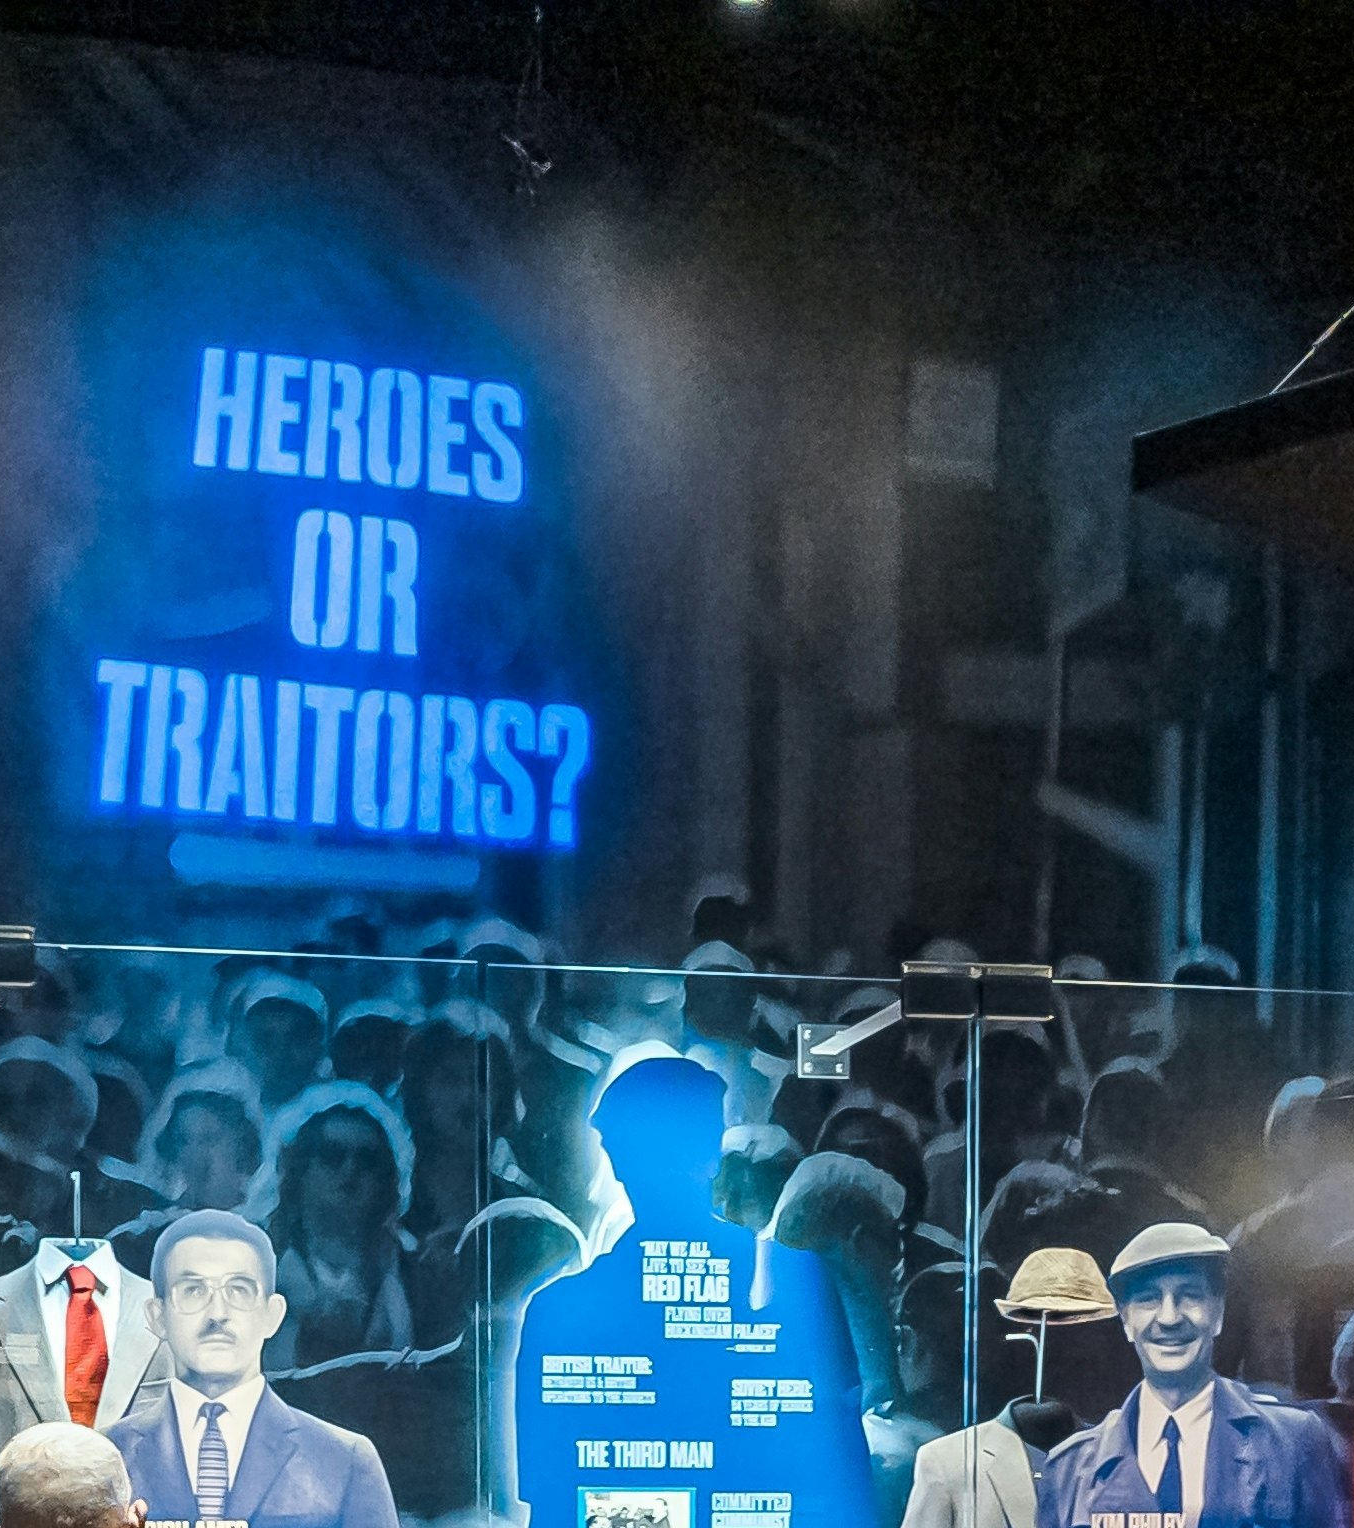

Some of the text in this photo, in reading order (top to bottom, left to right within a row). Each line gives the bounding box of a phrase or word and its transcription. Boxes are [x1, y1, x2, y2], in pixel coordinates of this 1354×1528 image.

[193, 346, 525, 503] HEROES
[290, 508, 419, 656] OR
[96, 658, 591, 844] TRAITORS?
[669, 1241, 688, 1257] WE
[689, 1242, 711, 1257] ALL
[643, 1258, 668, 1273] LIVE
[669, 1258, 684, 1273] TO
[707, 1259, 730, 1274] THE
[643, 1274, 729, 1302] RED FLAG
[576, 1441, 713, 1469] THE THIRD MAN
[712, 1493, 792, 1511] COMMITTED
